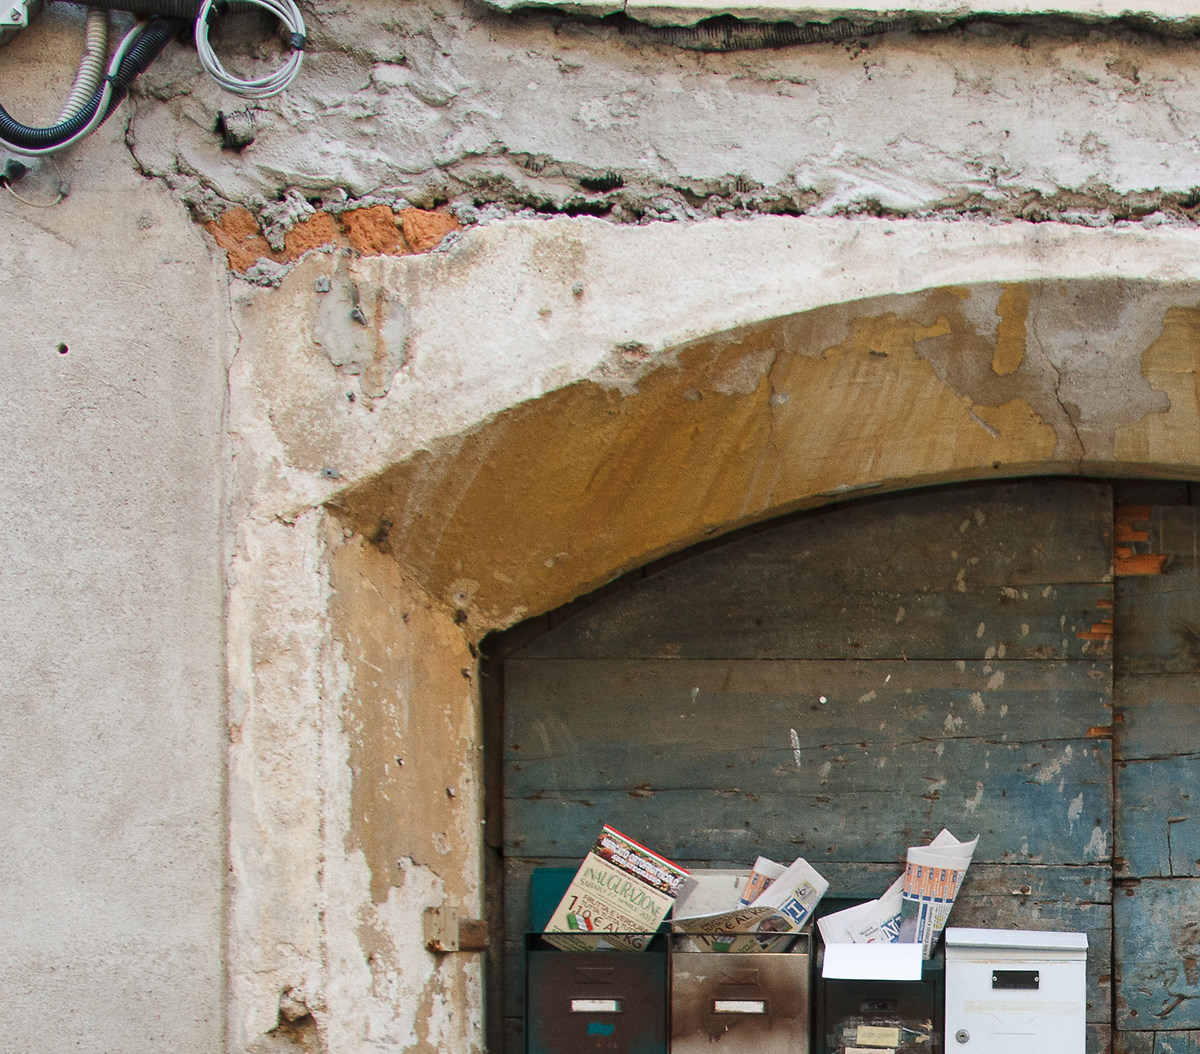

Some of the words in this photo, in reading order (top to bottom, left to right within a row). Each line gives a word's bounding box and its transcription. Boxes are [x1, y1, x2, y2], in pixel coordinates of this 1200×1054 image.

[583, 867, 662, 917] INAUGURAZIONE
[580, 901, 599, 914] TUTTA
[600, 911, 621, 926] TUTTA
[582, 894, 610, 913] FRUTTA
[610, 909, 617, 917] E
[593, 916, 602, 926] €
